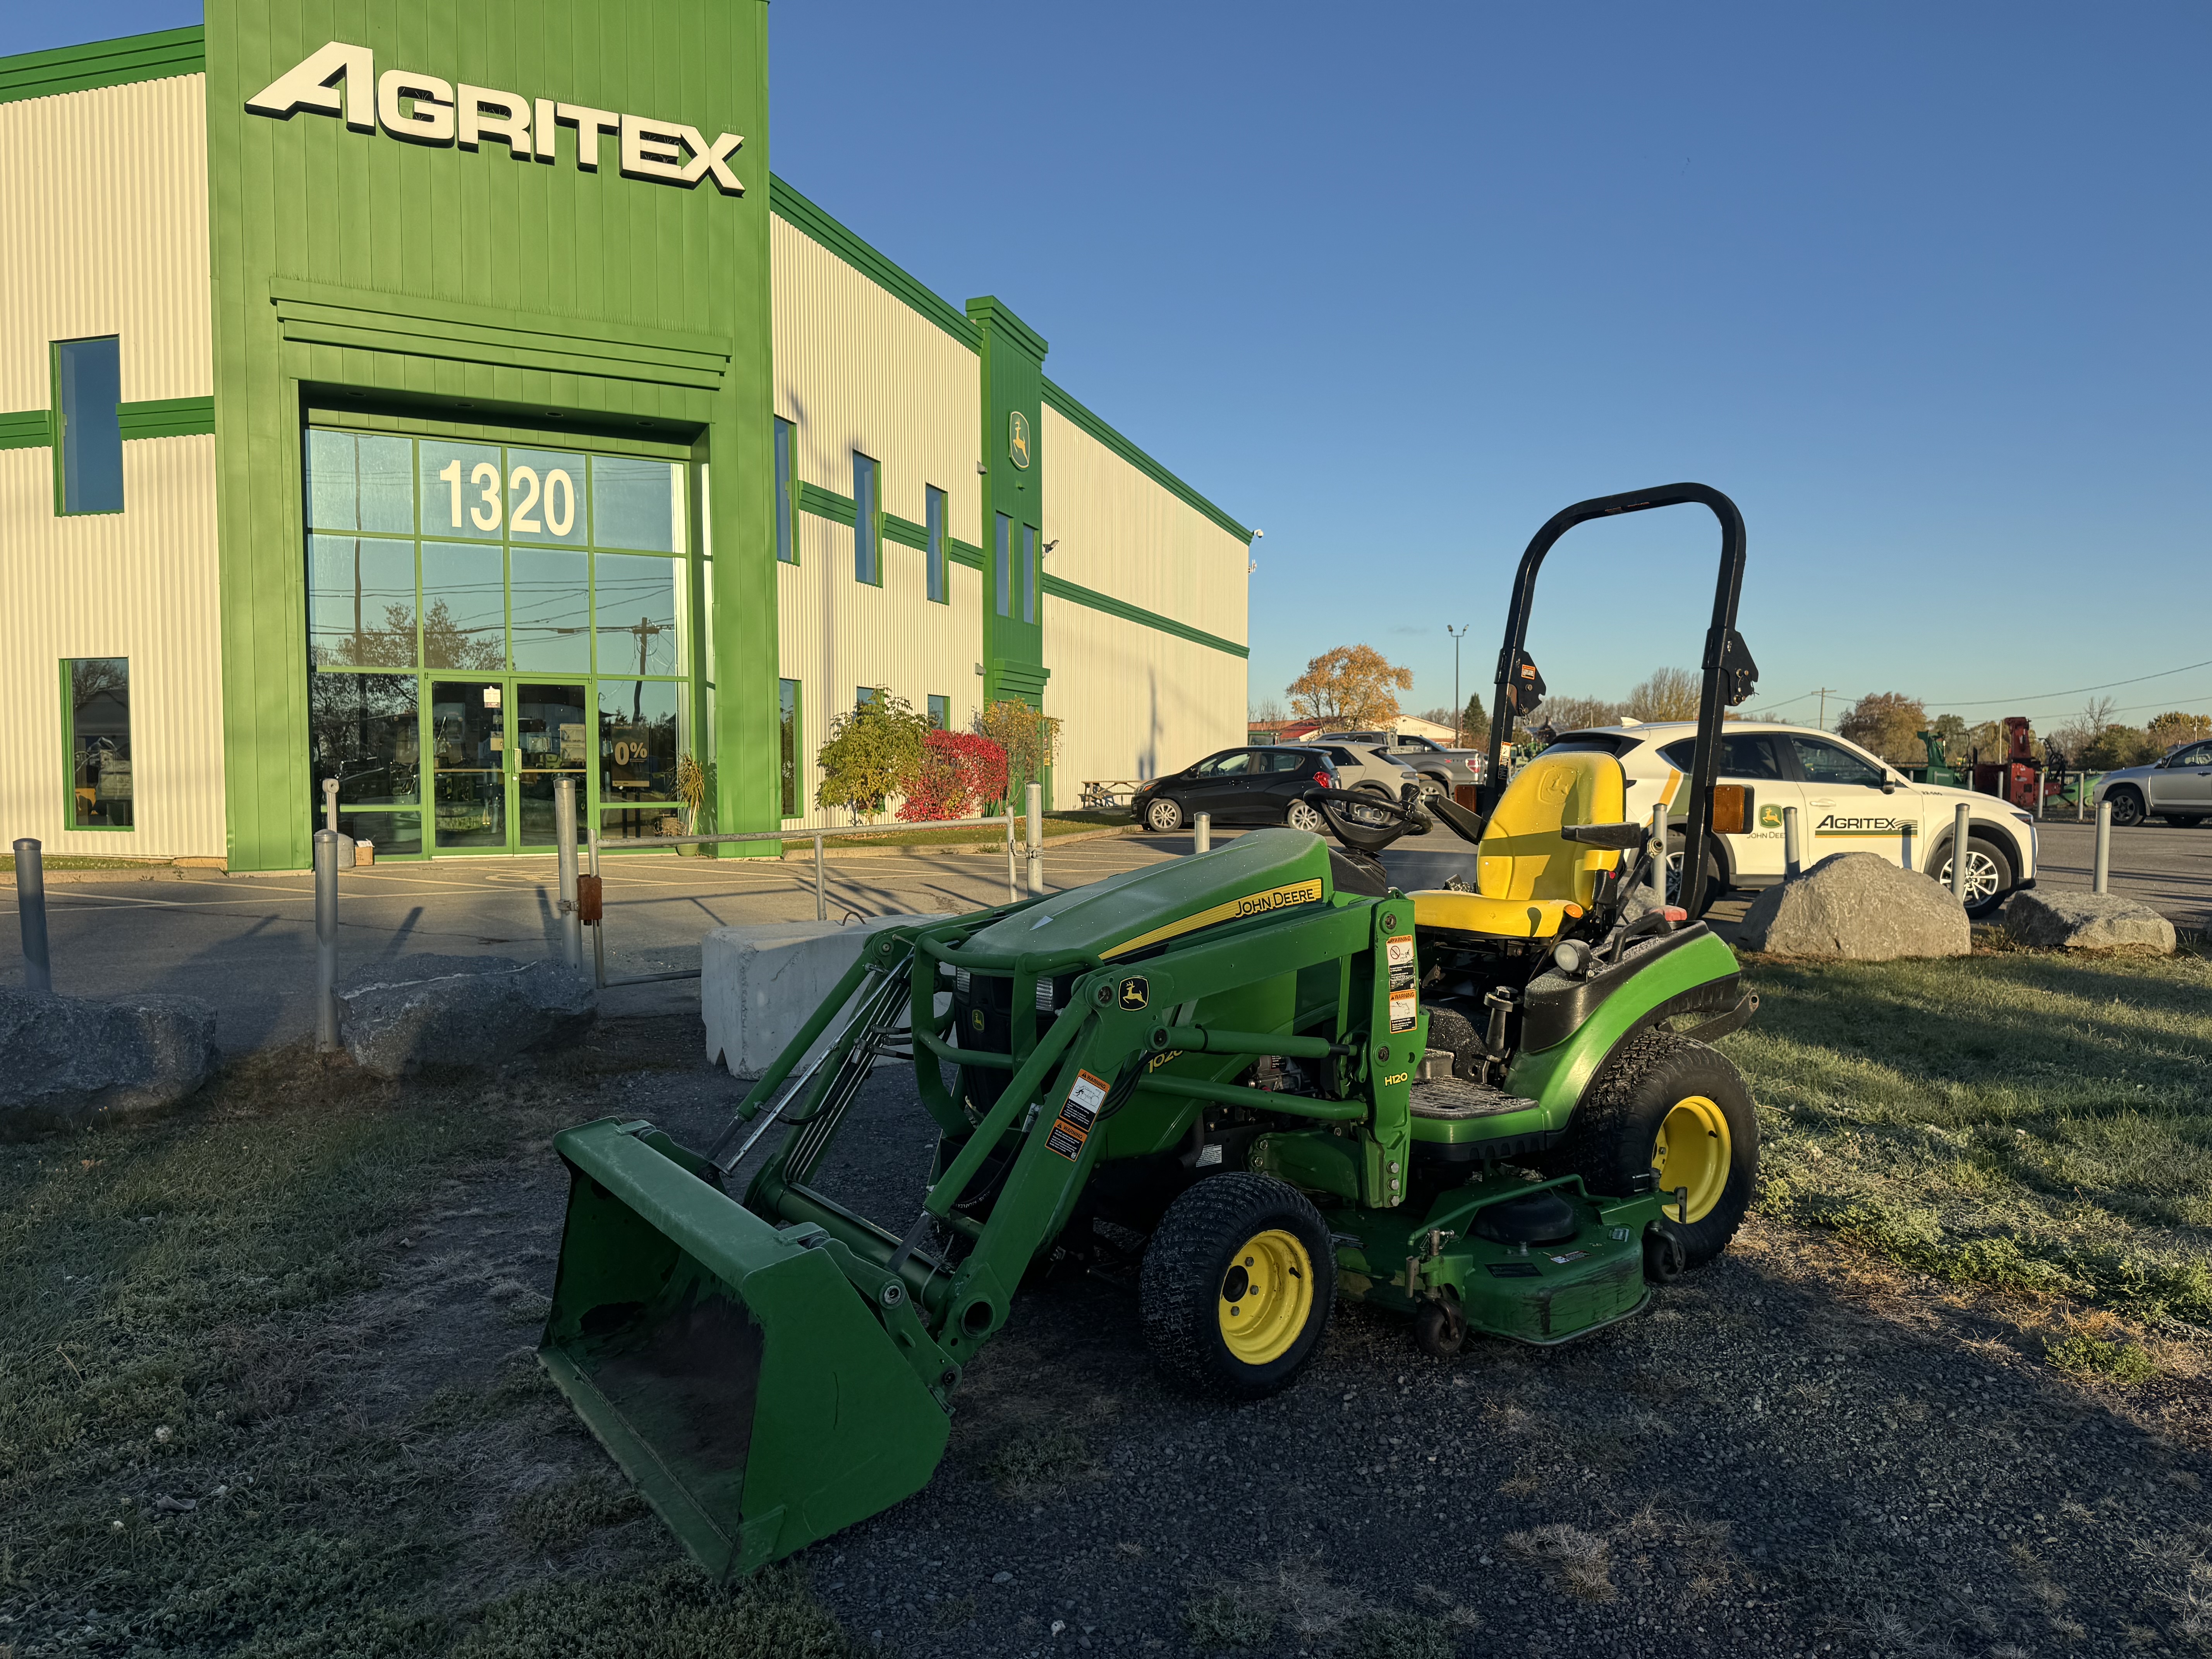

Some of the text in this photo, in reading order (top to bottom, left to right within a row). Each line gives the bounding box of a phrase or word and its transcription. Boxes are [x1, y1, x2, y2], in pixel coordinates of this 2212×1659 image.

[244, 41, 745, 197] AGRITEX
[440, 459, 575, 536] 1320
[615, 742, 647, 765] 0%
[1816, 815, 1896, 829] AGRITEX
[1235, 889, 1314, 916] JOHN DEERE
[1087, 1075, 1106, 1089] WARNING
[1384, 1072, 1407, 1086] H120
[1063, 1125, 1083, 1139] WARNING
